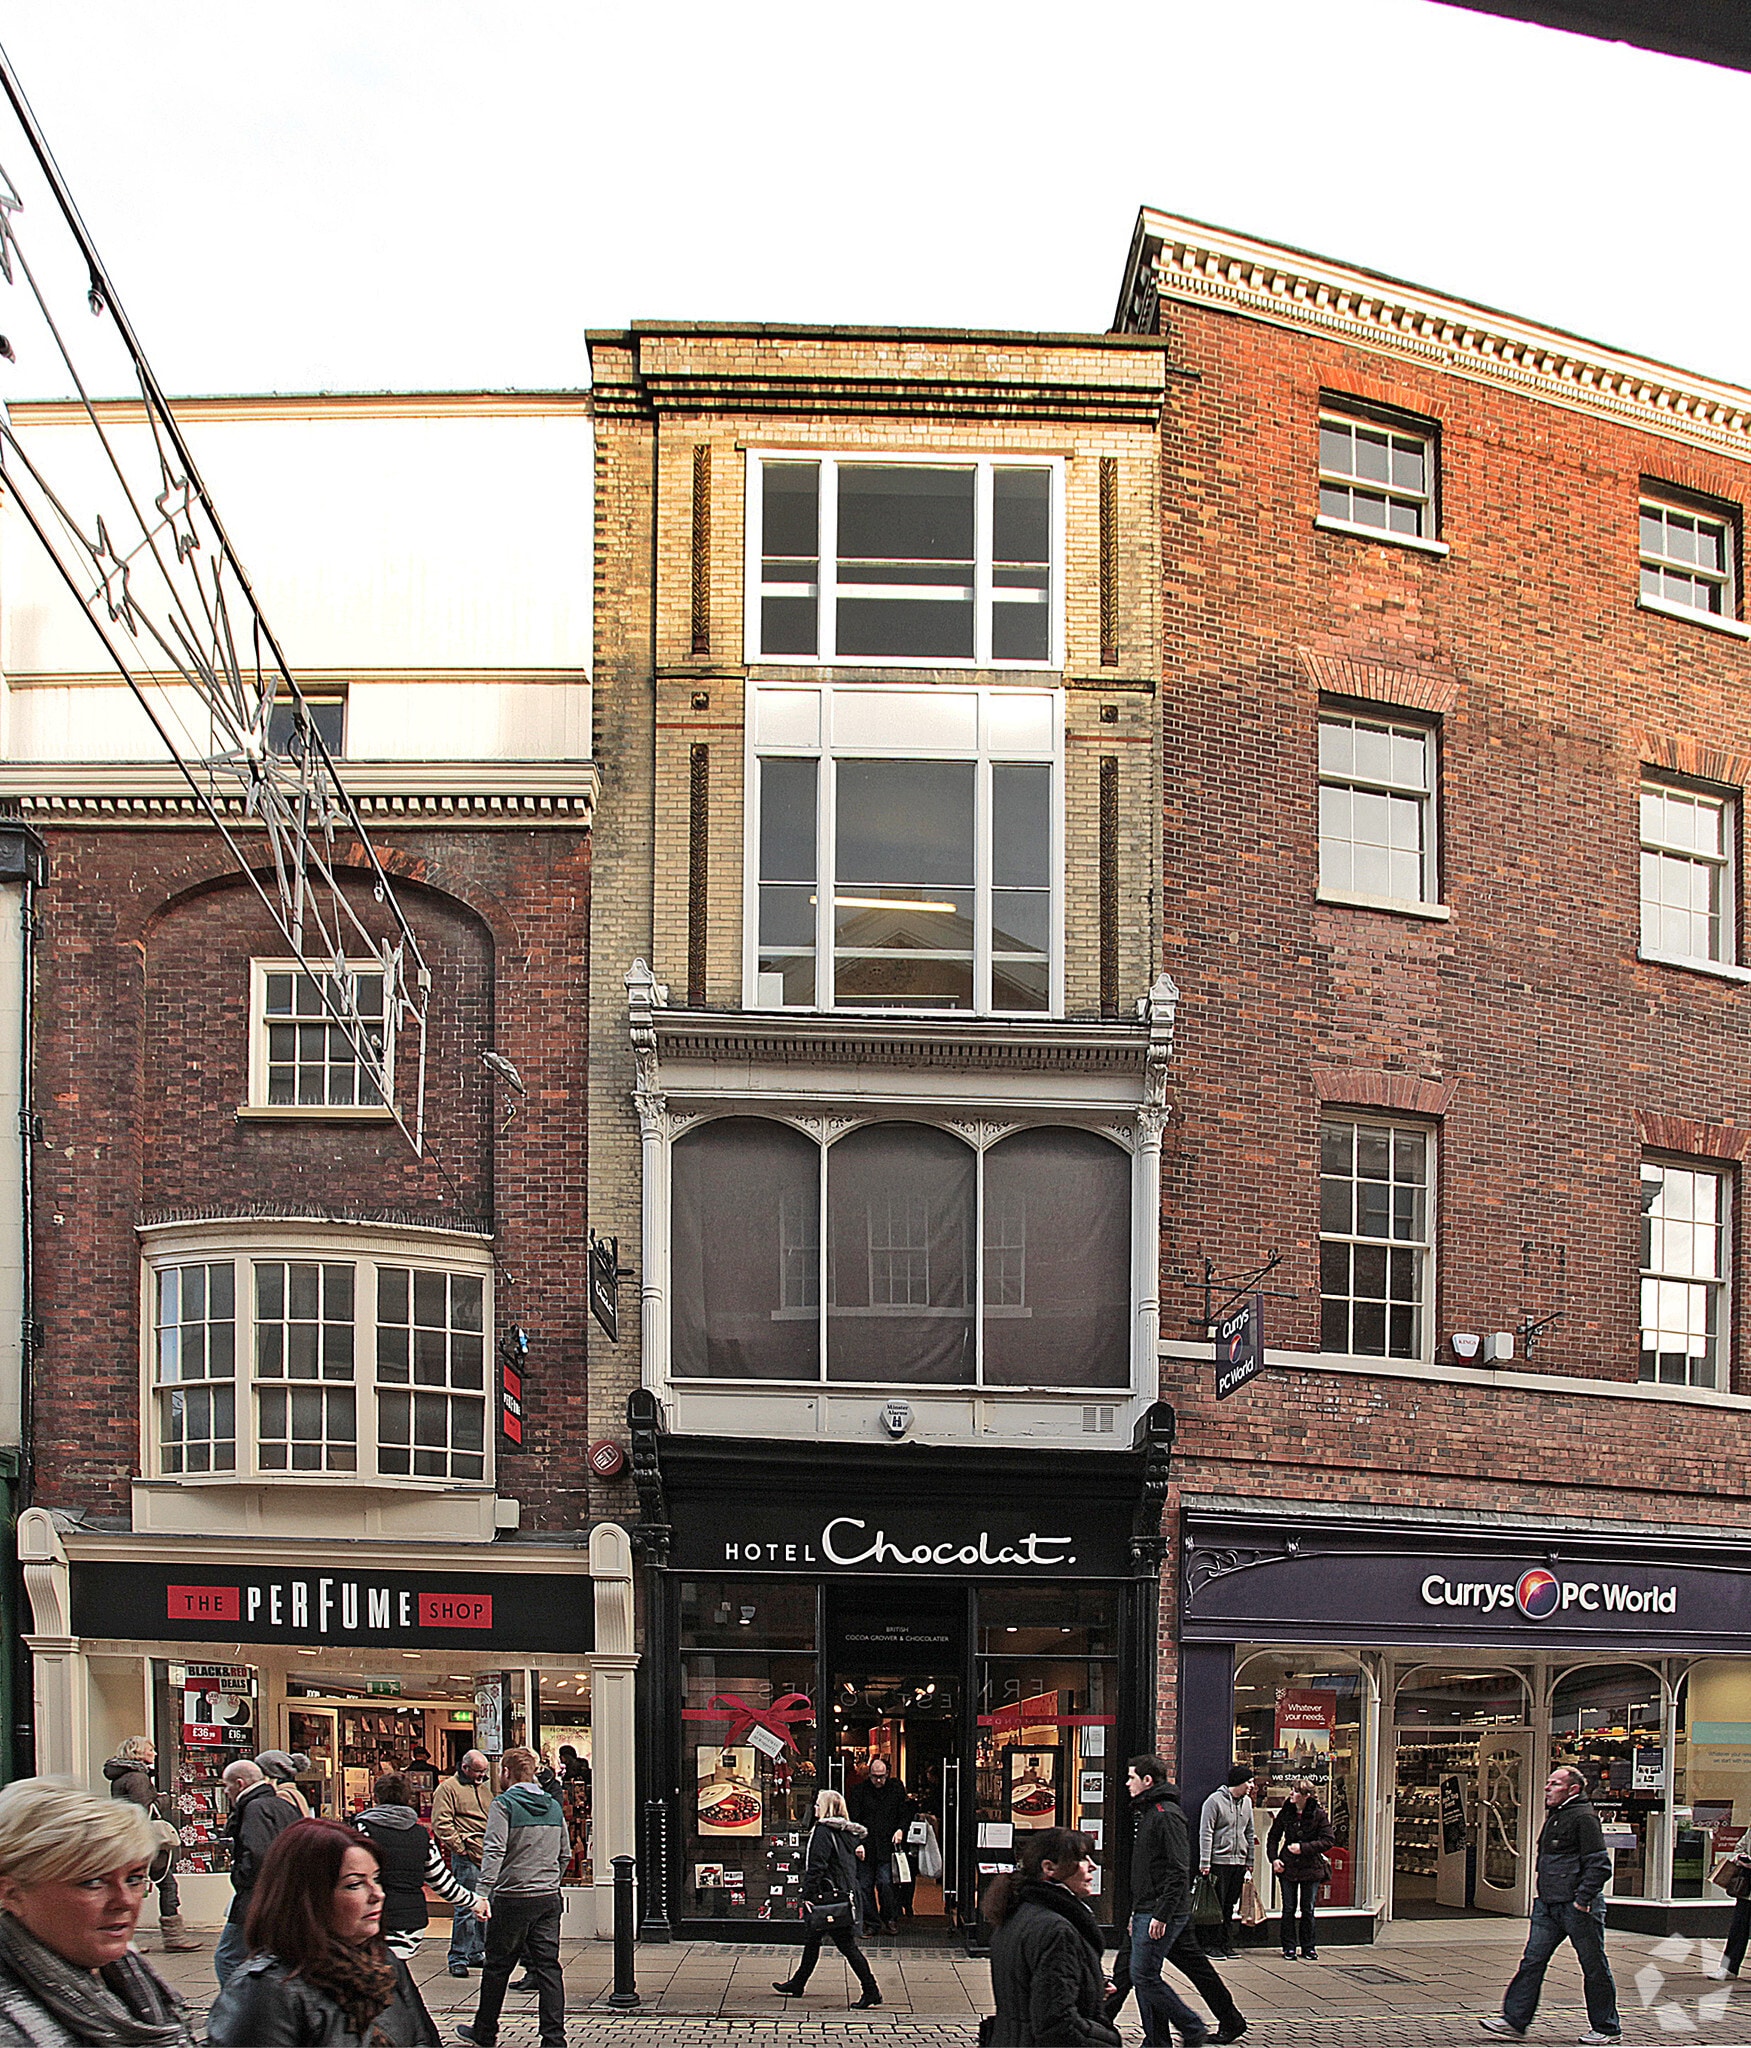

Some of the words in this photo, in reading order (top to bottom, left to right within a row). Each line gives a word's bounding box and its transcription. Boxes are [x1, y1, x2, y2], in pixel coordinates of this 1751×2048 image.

[1223, 1308, 1249, 1338] Currys
[1219, 1373, 1231, 1393] PC
[1230, 1356, 1254, 1385] World
[725, 1542, 816, 1562] HOTEL
[1421, 1574, 1515, 1613] Currys
[1562, 1582, 1600, 1611] PC
[1602, 1583, 1677, 1614] World
[184, 1594, 223, 1612] THE
[247, 1578, 411, 1633] PERFUME
[429, 1602, 484, 1620] SHOP
[188, 1666, 248, 1677] BLACK&RED
[221, 1678, 246, 1688] DEALS
[1287, 1703, 1323, 1712] Whatever
[1284, 1713, 1301, 1721] your
[1284, 1773, 1301, 1781] start
[1302, 1773, 1318, 1781] with
